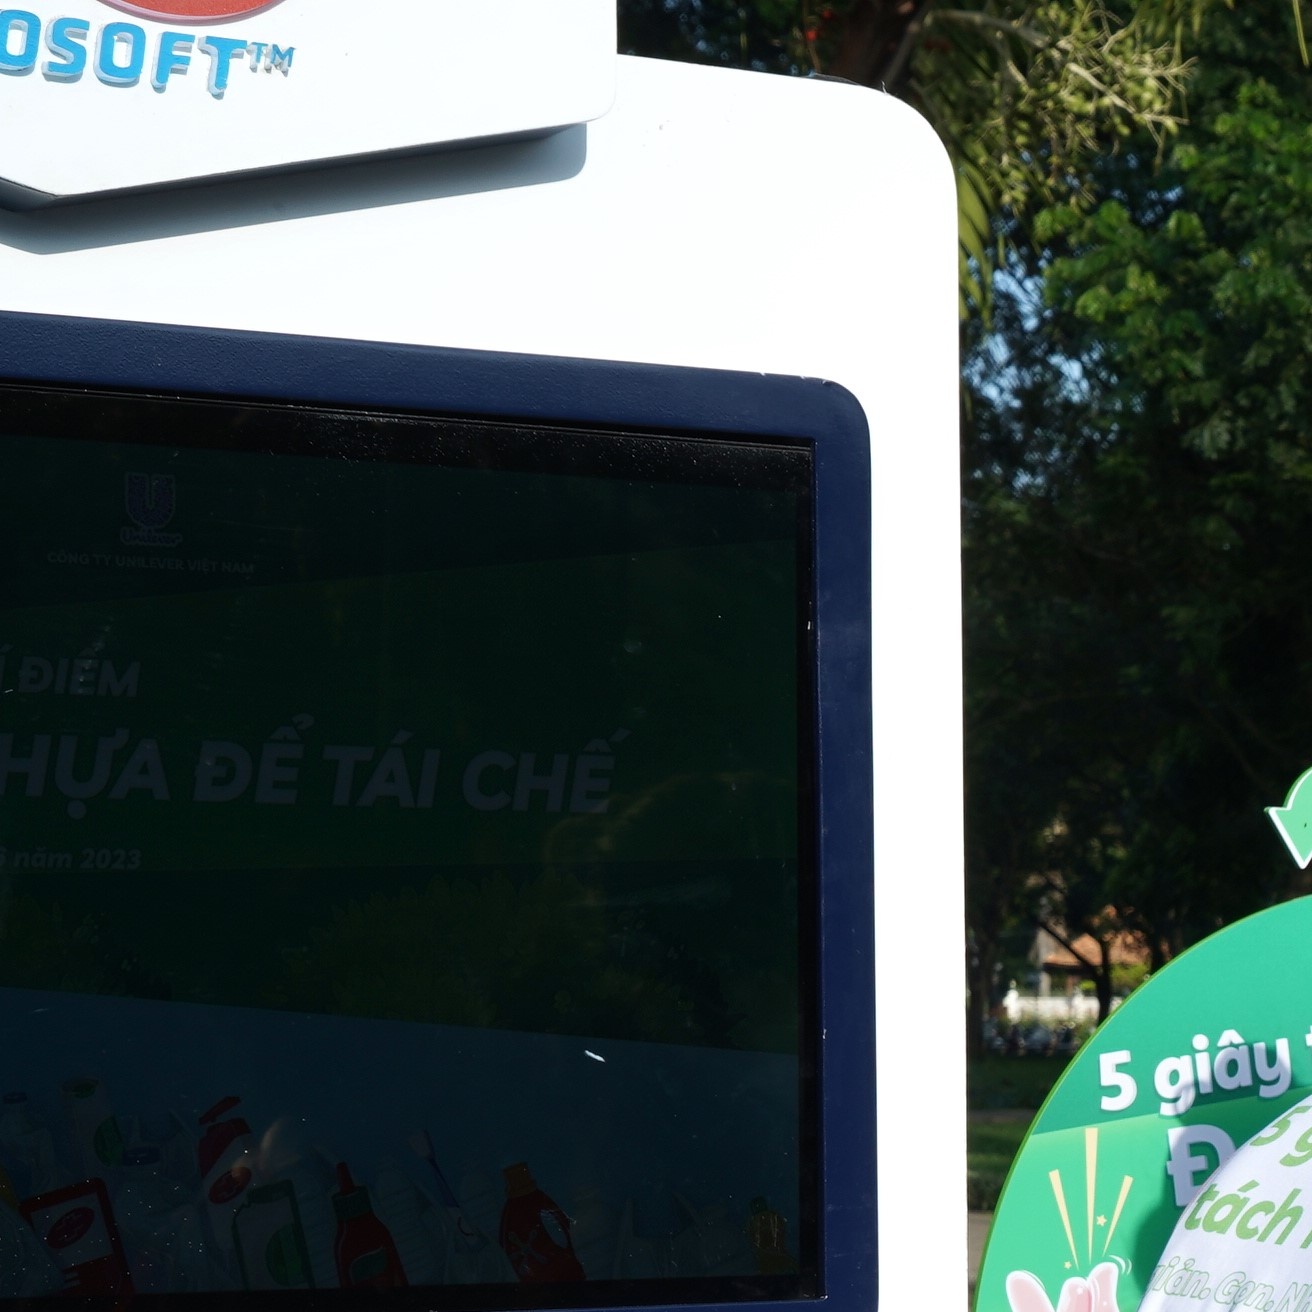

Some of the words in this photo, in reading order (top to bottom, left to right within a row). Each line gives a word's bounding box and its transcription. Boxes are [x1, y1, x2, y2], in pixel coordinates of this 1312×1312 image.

[192, 712, 316, 804] ĐỂ
[322, 728, 442, 810] TÁI
[461, 727, 632, 815] CHẾ
[13, 846, 74, 869] năm
[80, 848, 142, 870] 2023
[1098, 1049, 1138, 1113] 5
[1154, 1028, 1293, 1117] giây
[1184, 1179, 1303, 1246] tách
